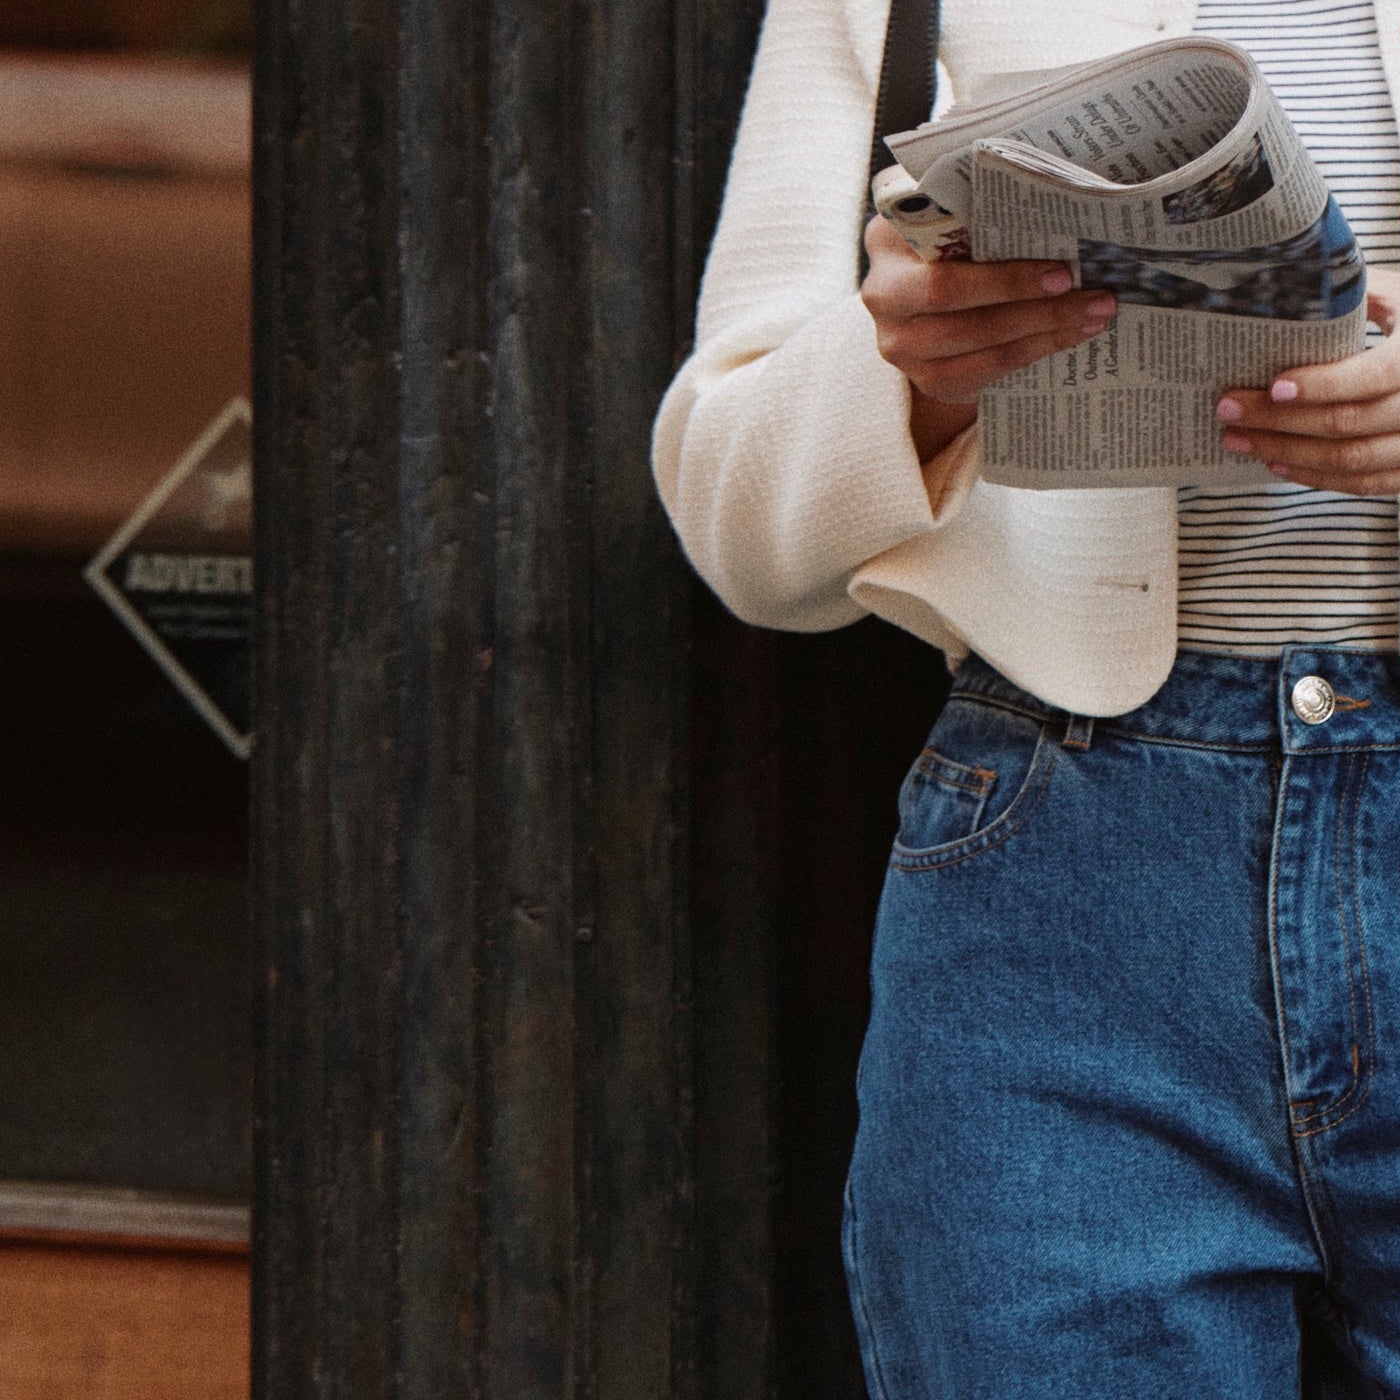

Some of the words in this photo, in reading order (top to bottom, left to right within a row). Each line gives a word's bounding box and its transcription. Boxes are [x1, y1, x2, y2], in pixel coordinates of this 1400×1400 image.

[1083, 338, 1101, 380] Outrage,
[1103, 332, 1119, 367] Gender
[1062, 350, 1077, 386] Doctor,
[1105, 368, 1119, 377] A
